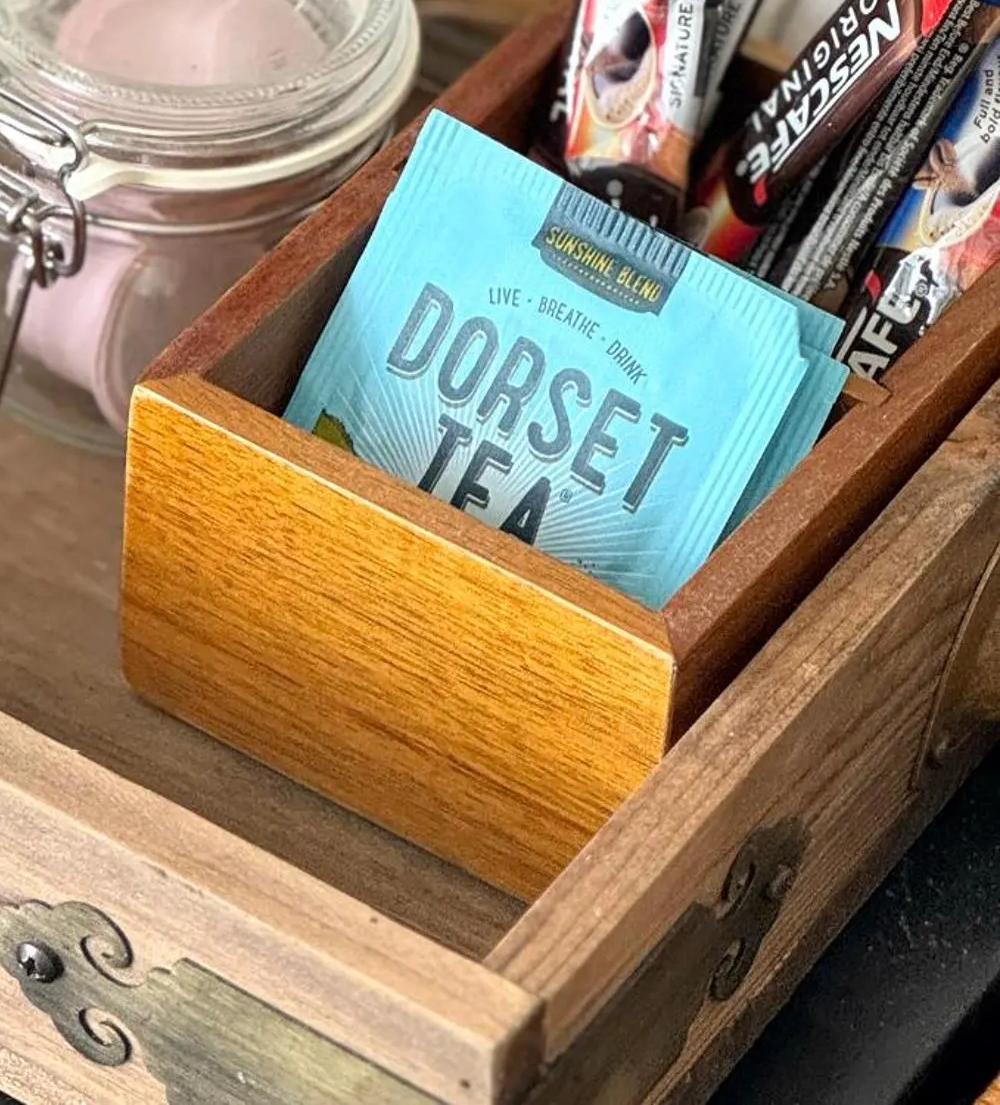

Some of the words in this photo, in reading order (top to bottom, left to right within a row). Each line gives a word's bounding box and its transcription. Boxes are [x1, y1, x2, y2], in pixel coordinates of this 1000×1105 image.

[669, 2, 694, 108] SIGNATURE
[973, 98, 991, 130] Full
[984, 68, 994, 96] and
[545, 226, 616, 277] SUNSHINE
[615, 264, 663, 303] BLEND
[489, 287, 521, 308] LIVE
[538, 296, 600, 340] BREATHE
[605, 340, 648, 385] DRINK
[385, 281, 689, 514] DORSET
